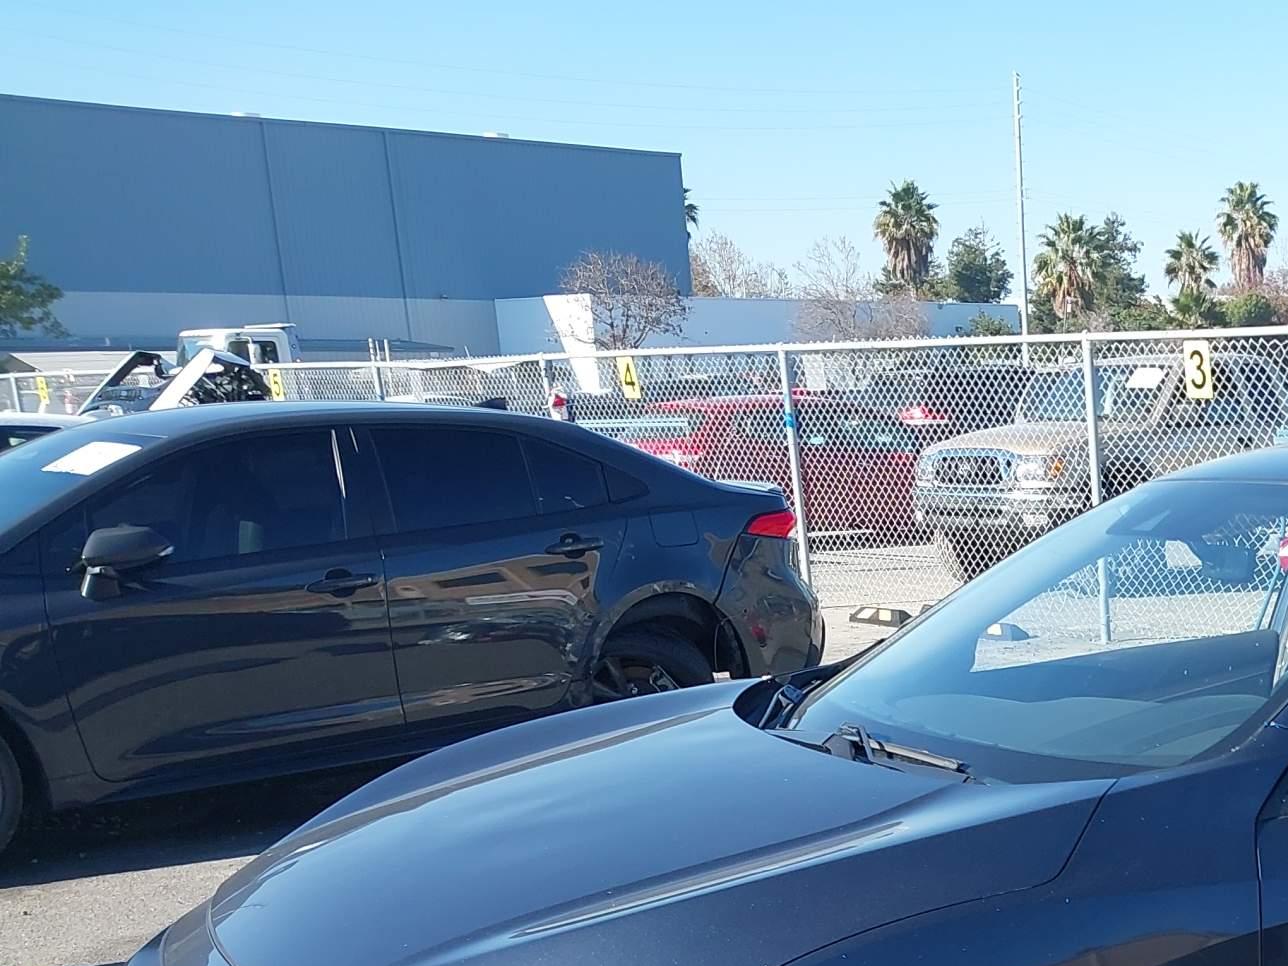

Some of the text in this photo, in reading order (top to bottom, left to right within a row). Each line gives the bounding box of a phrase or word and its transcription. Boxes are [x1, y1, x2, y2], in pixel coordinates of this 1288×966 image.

[272, 373, 281, 397] 5
[624, 362, 636, 393] 4
[1189, 349, 1207, 390] 3
